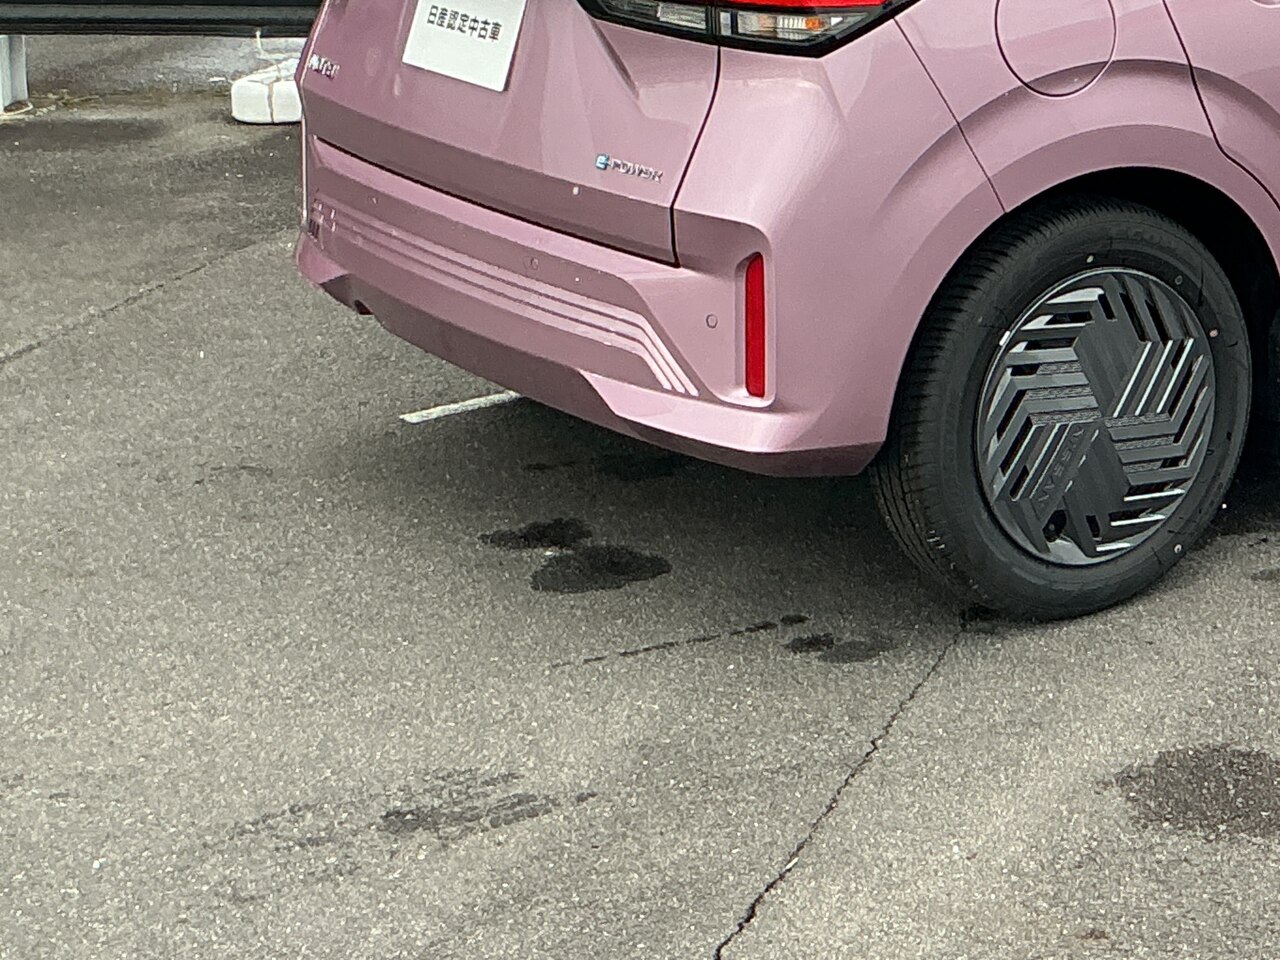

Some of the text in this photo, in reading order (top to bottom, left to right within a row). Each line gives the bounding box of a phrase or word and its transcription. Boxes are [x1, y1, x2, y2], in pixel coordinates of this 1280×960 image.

[426, 4, 502, 41] 日産認定中古車
